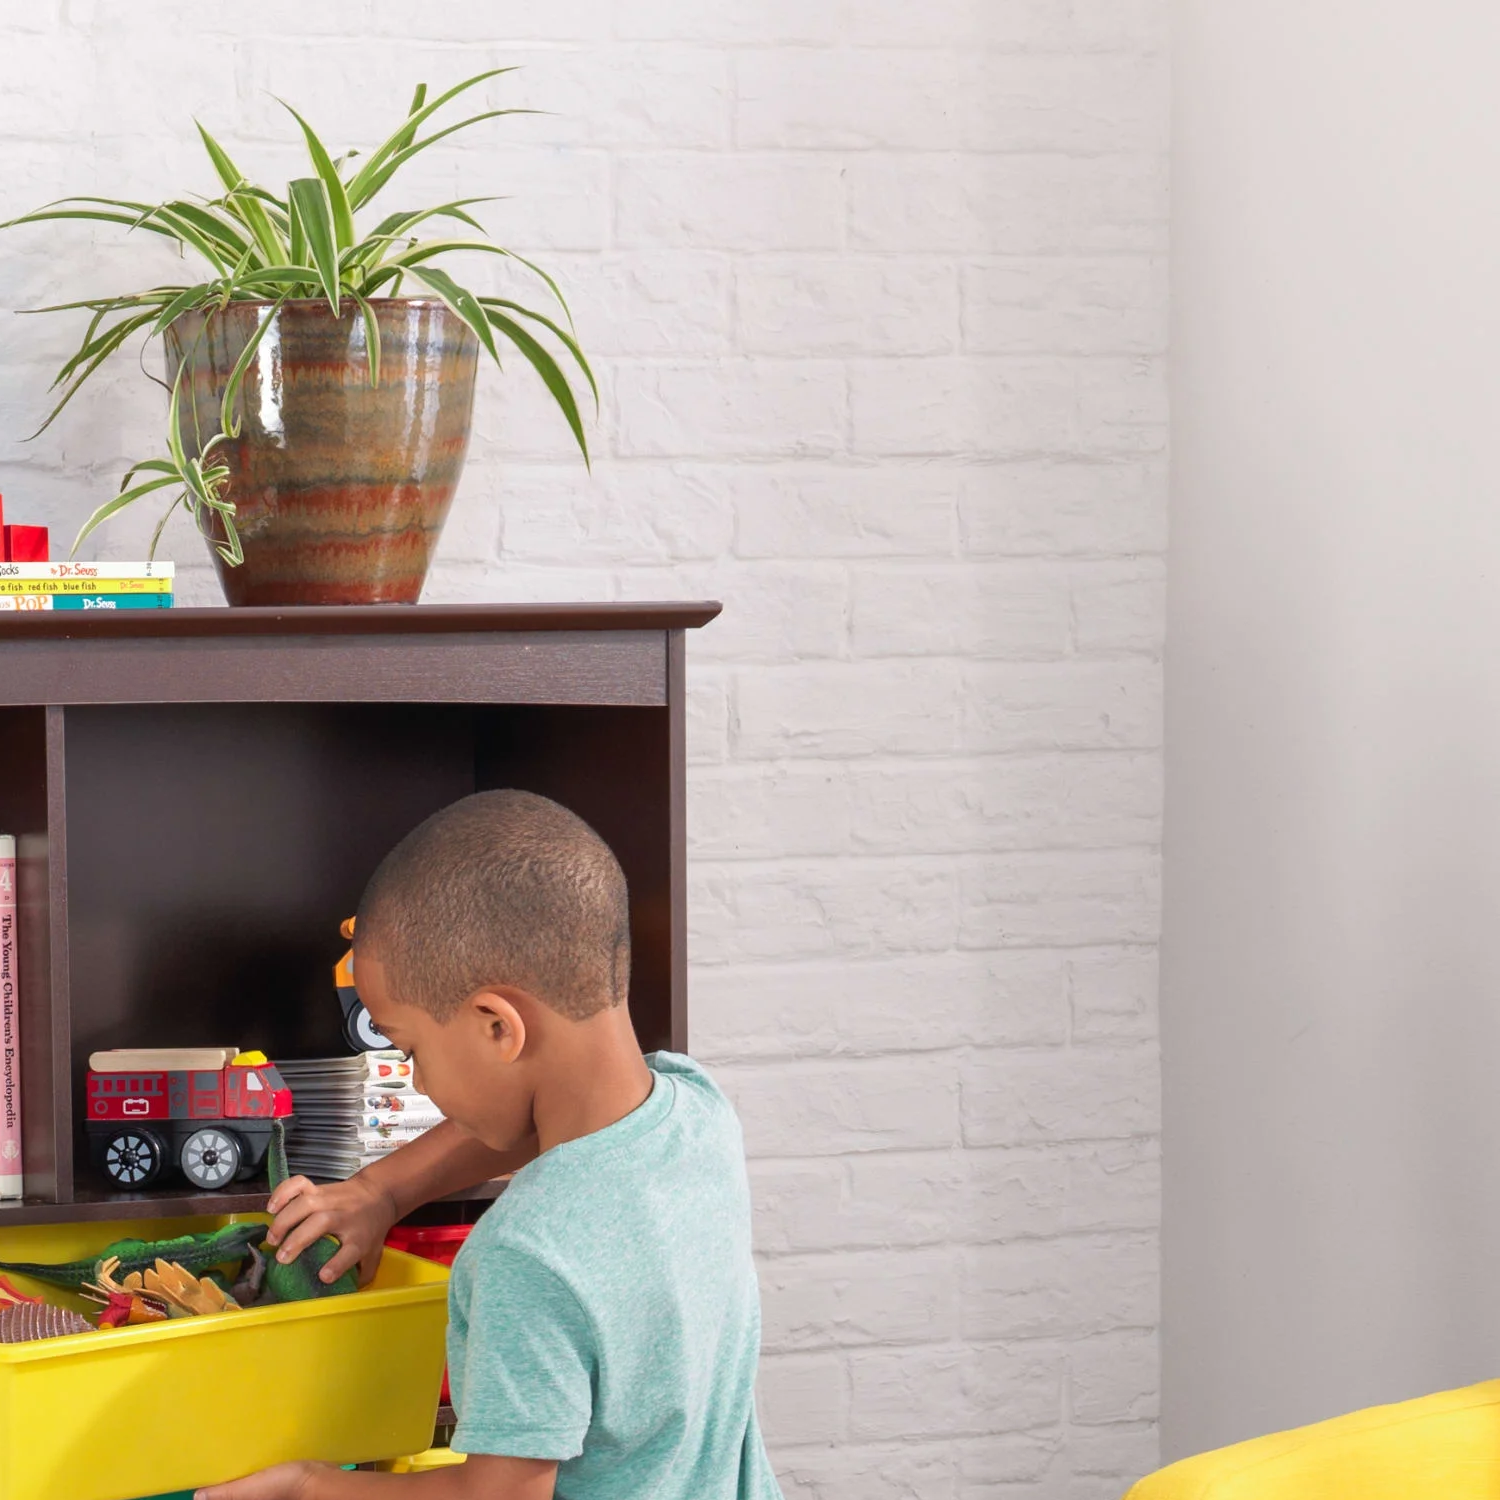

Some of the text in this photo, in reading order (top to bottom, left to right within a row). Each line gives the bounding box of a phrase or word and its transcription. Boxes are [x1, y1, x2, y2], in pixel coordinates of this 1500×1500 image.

[58, 565, 73, 576] Dr.
[74, 563, 98, 576] Seuss
[8, 583, 23, 591] fish
[28, 582, 40, 590] red
[43, 582, 58, 590] fish
[63, 582, 79, 590] blue
[82, 582, 97, 590] fish
[13, 594, 48, 611] POP
[95, 596, 117, 609] Seuss
[0, 868, 12, 892] 4
[1, 915, 17, 1129] The Young Children's Encyclopedia
